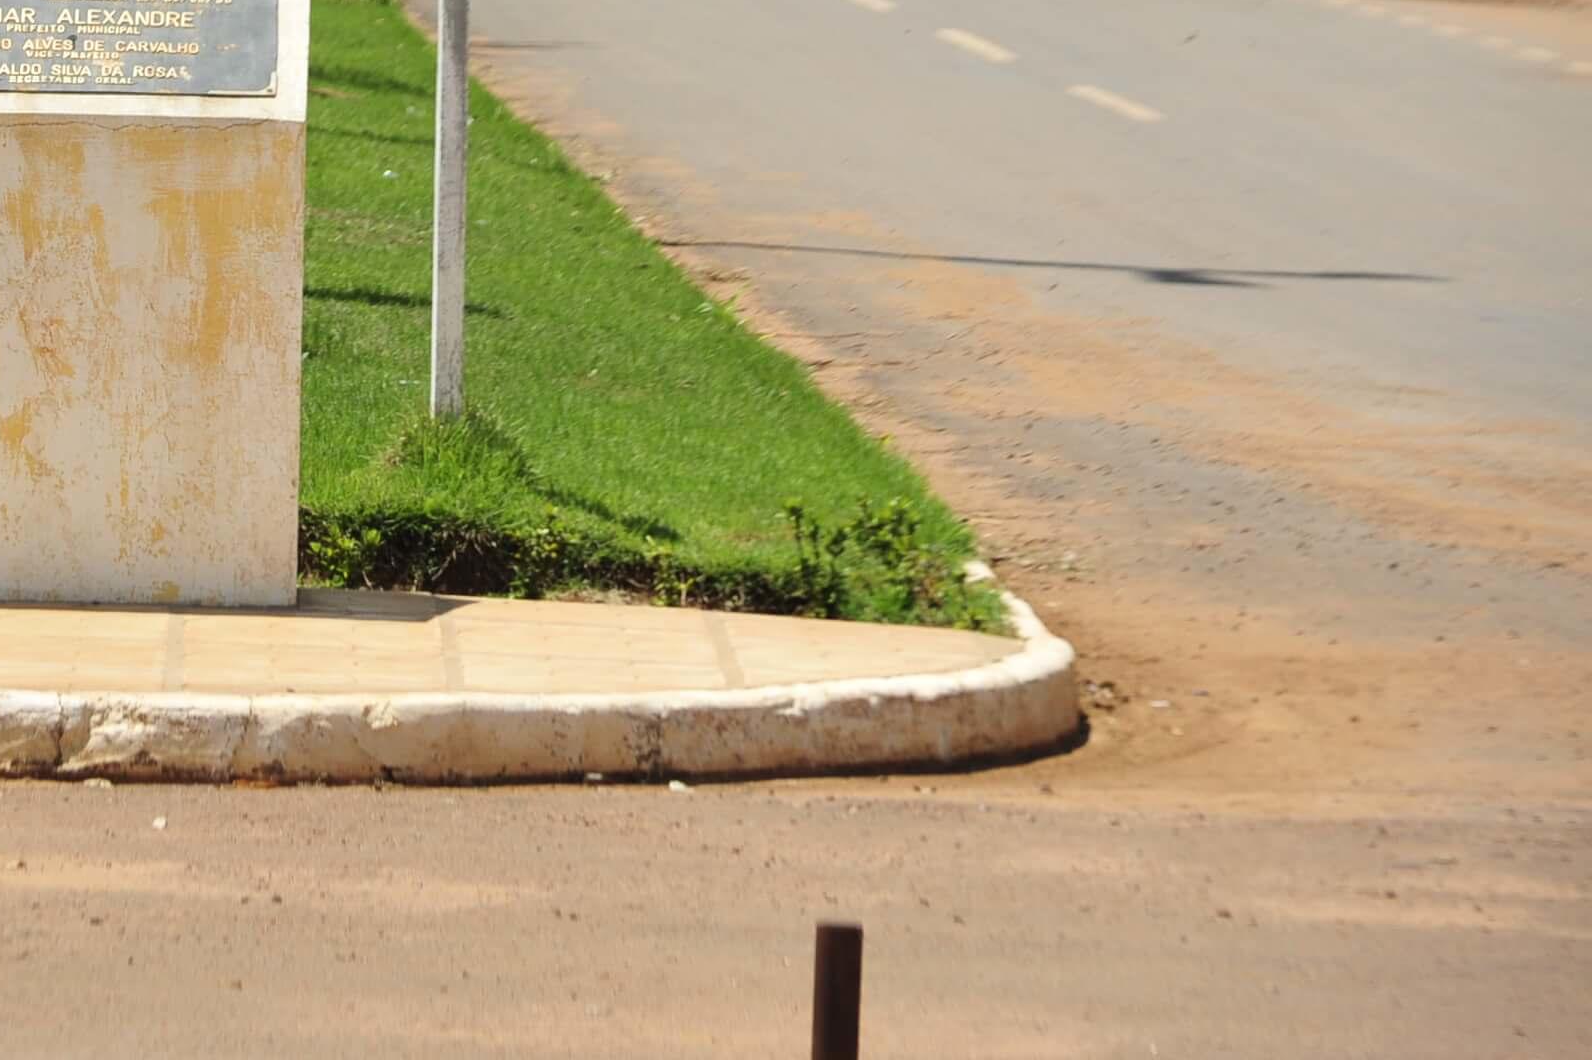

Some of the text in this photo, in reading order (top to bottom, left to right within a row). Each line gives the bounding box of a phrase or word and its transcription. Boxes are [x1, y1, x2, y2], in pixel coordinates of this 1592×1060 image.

[57, 8, 195, 28] ALEXANDRE
[6, 23, 142, 35] PREFEITO MUNICIPAL
[22, 38, 74, 51] ALVES
[83, 39, 105, 51] DE
[115, 40, 200, 55] CARVALHO
[50, 63, 92, 77] SILVA
[101, 65, 124, 77] DA
[133, 65, 179, 79] ROSA
